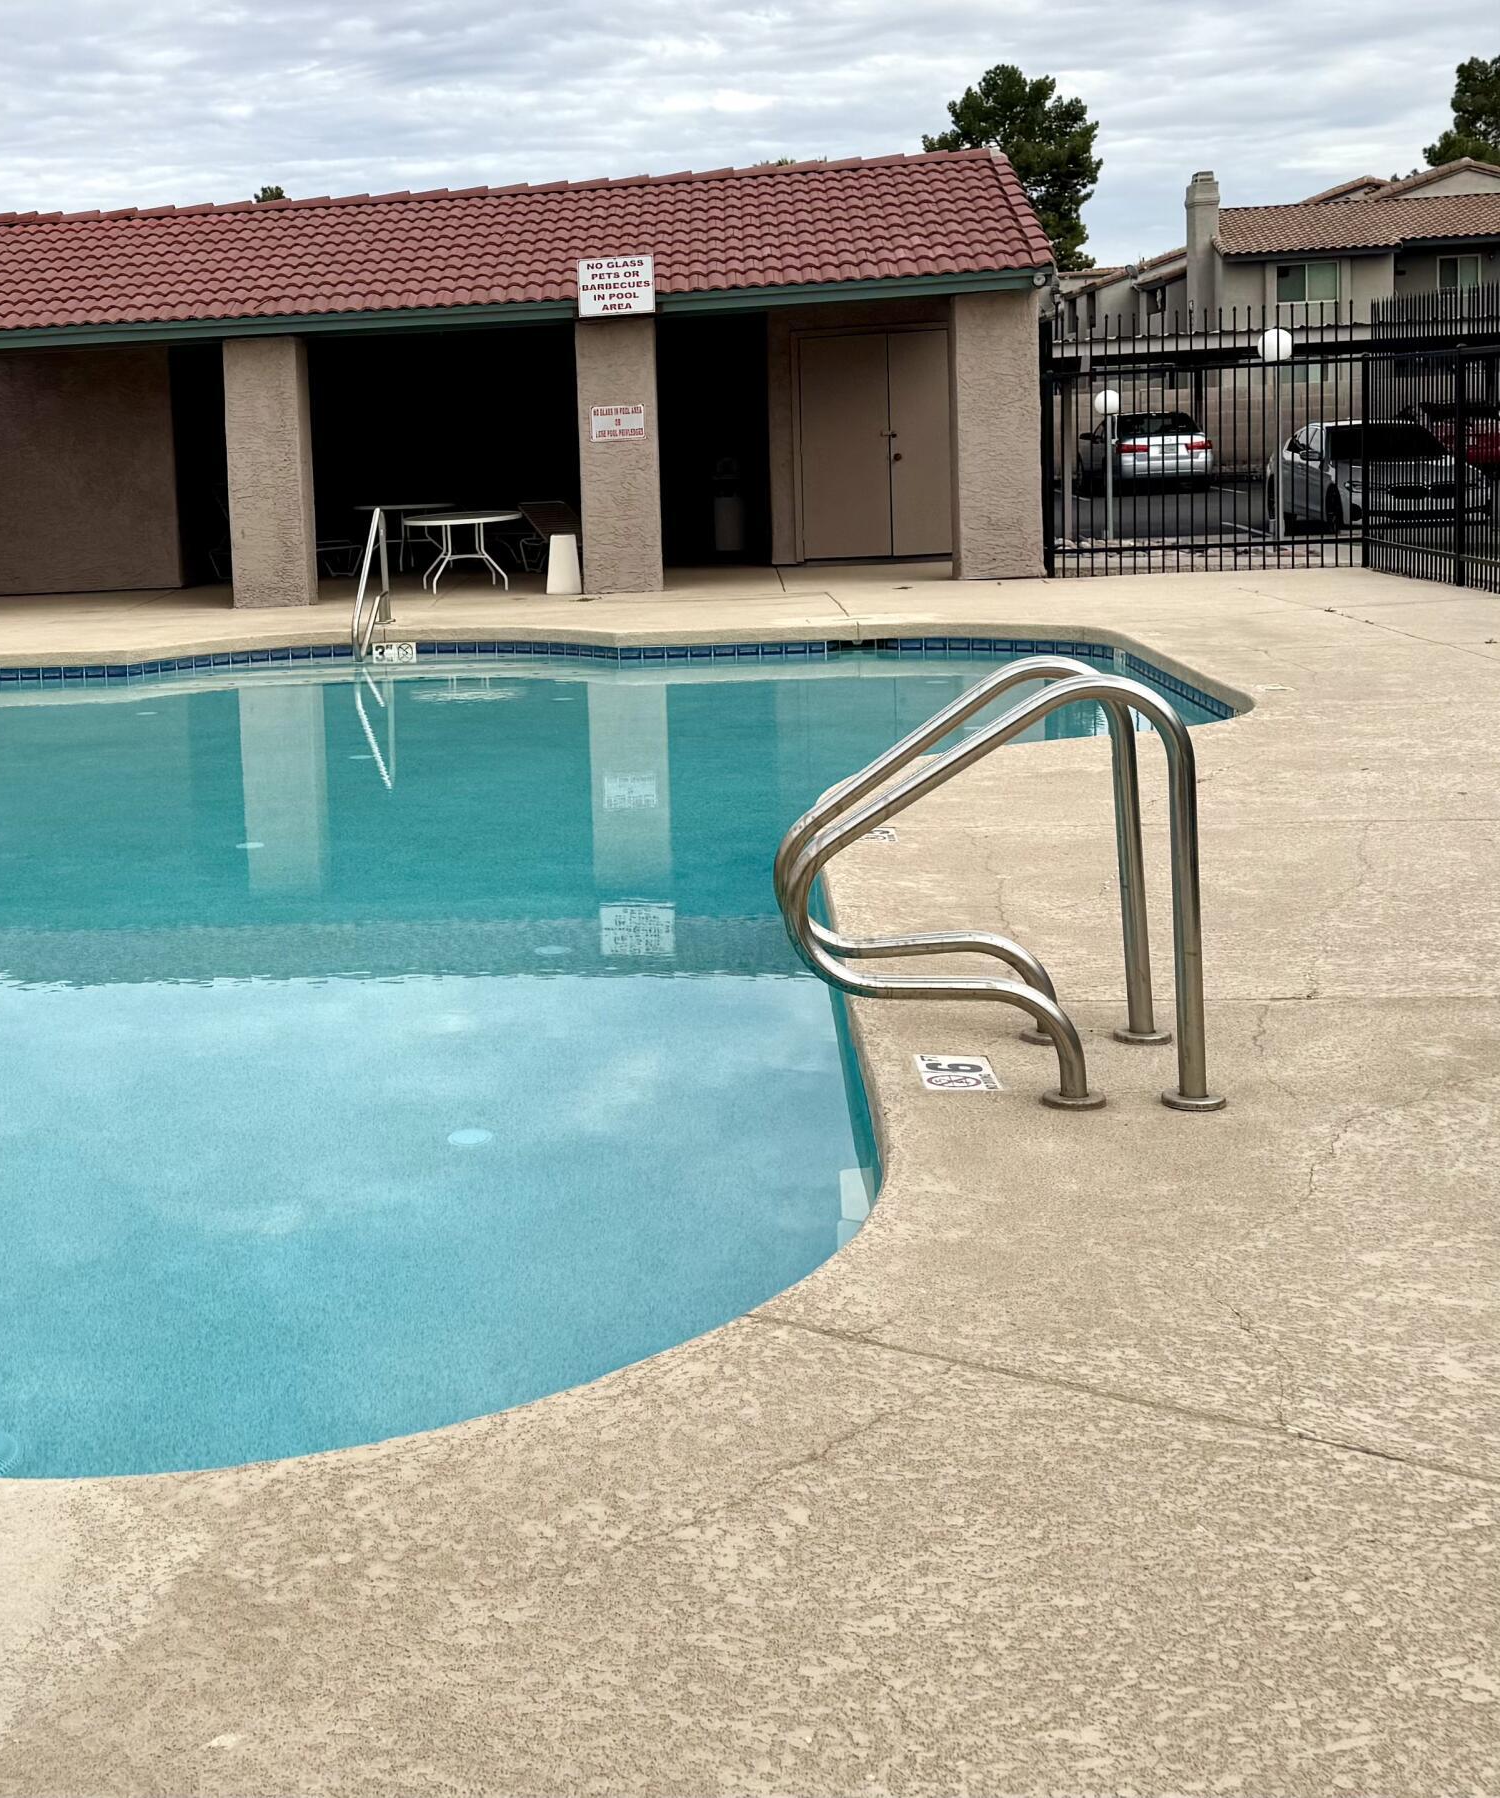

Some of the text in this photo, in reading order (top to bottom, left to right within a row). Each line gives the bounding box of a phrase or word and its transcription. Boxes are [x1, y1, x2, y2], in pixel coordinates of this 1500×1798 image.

[607, 260, 644, 269] GLASS
[591, 270, 640, 280] PETS OR
[582, 280, 650, 291] BARBECUES
[609, 292, 639, 301] POOL
[602, 303, 632, 311] AREA
